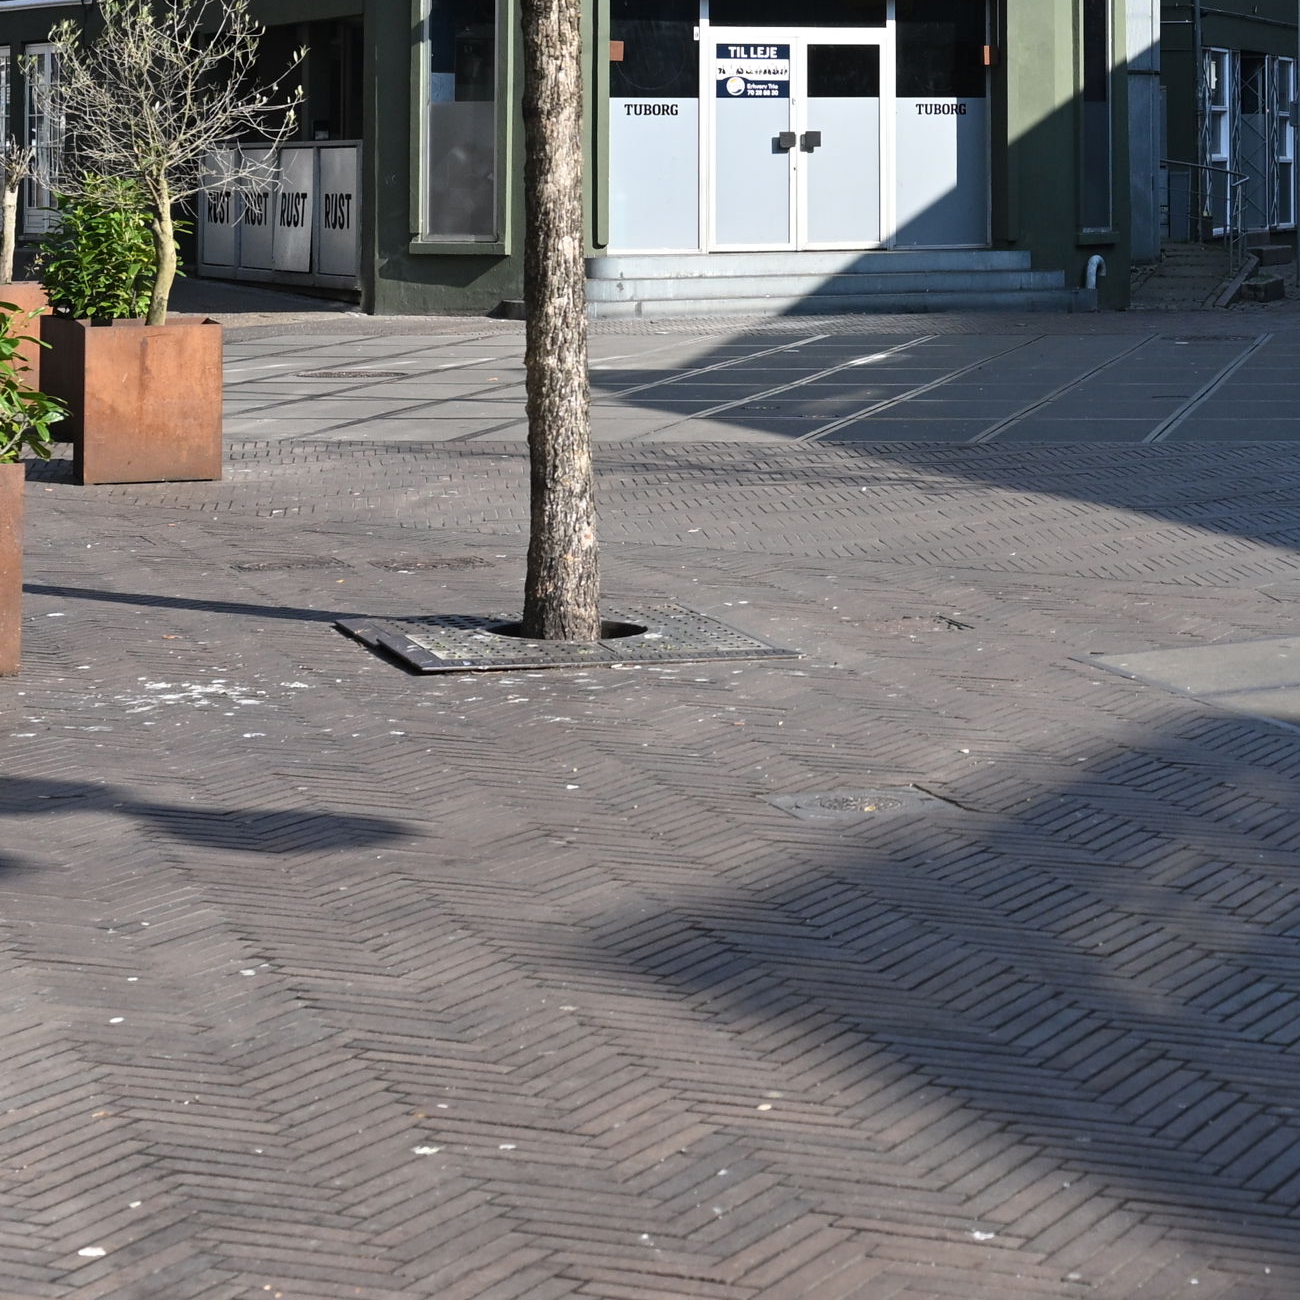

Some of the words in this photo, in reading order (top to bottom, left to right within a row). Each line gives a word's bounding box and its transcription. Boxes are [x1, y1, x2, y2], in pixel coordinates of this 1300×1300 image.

[728, 46, 747, 58] TIL
[750, 46, 777, 58] LEJE
[624, 103, 678, 116] TUBORG
[915, 103, 966, 116] TUBORG
[207, 191, 231, 224] RUST
[244, 192, 268, 226] RUST
[280, 192, 307, 227] RUST
[324, 193, 352, 229] RUST
